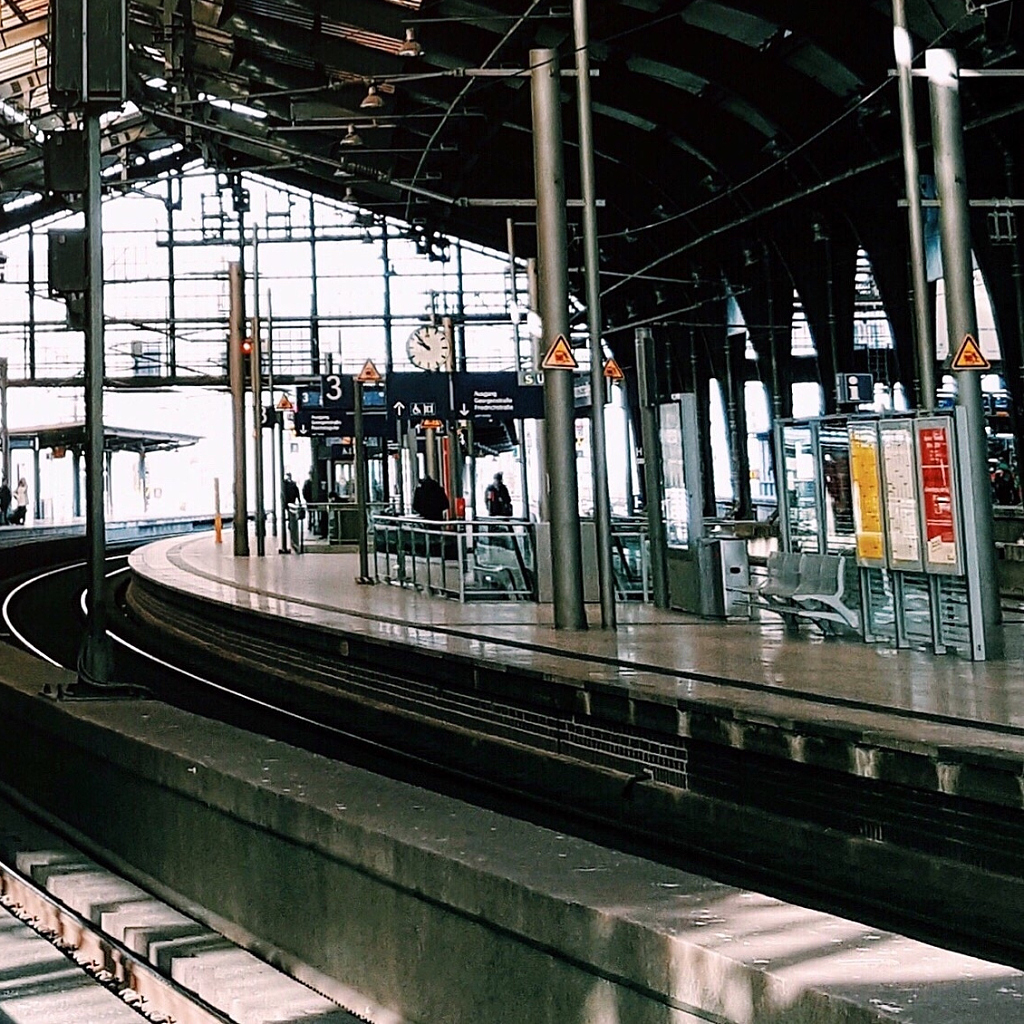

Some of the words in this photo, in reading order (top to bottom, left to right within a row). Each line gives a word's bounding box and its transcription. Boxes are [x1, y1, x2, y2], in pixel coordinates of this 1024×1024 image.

[525, 374, 533, 384] S
[537, 373, 544, 384] U
[326, 375, 342, 401] 3
[302, 392, 309, 403] 3
